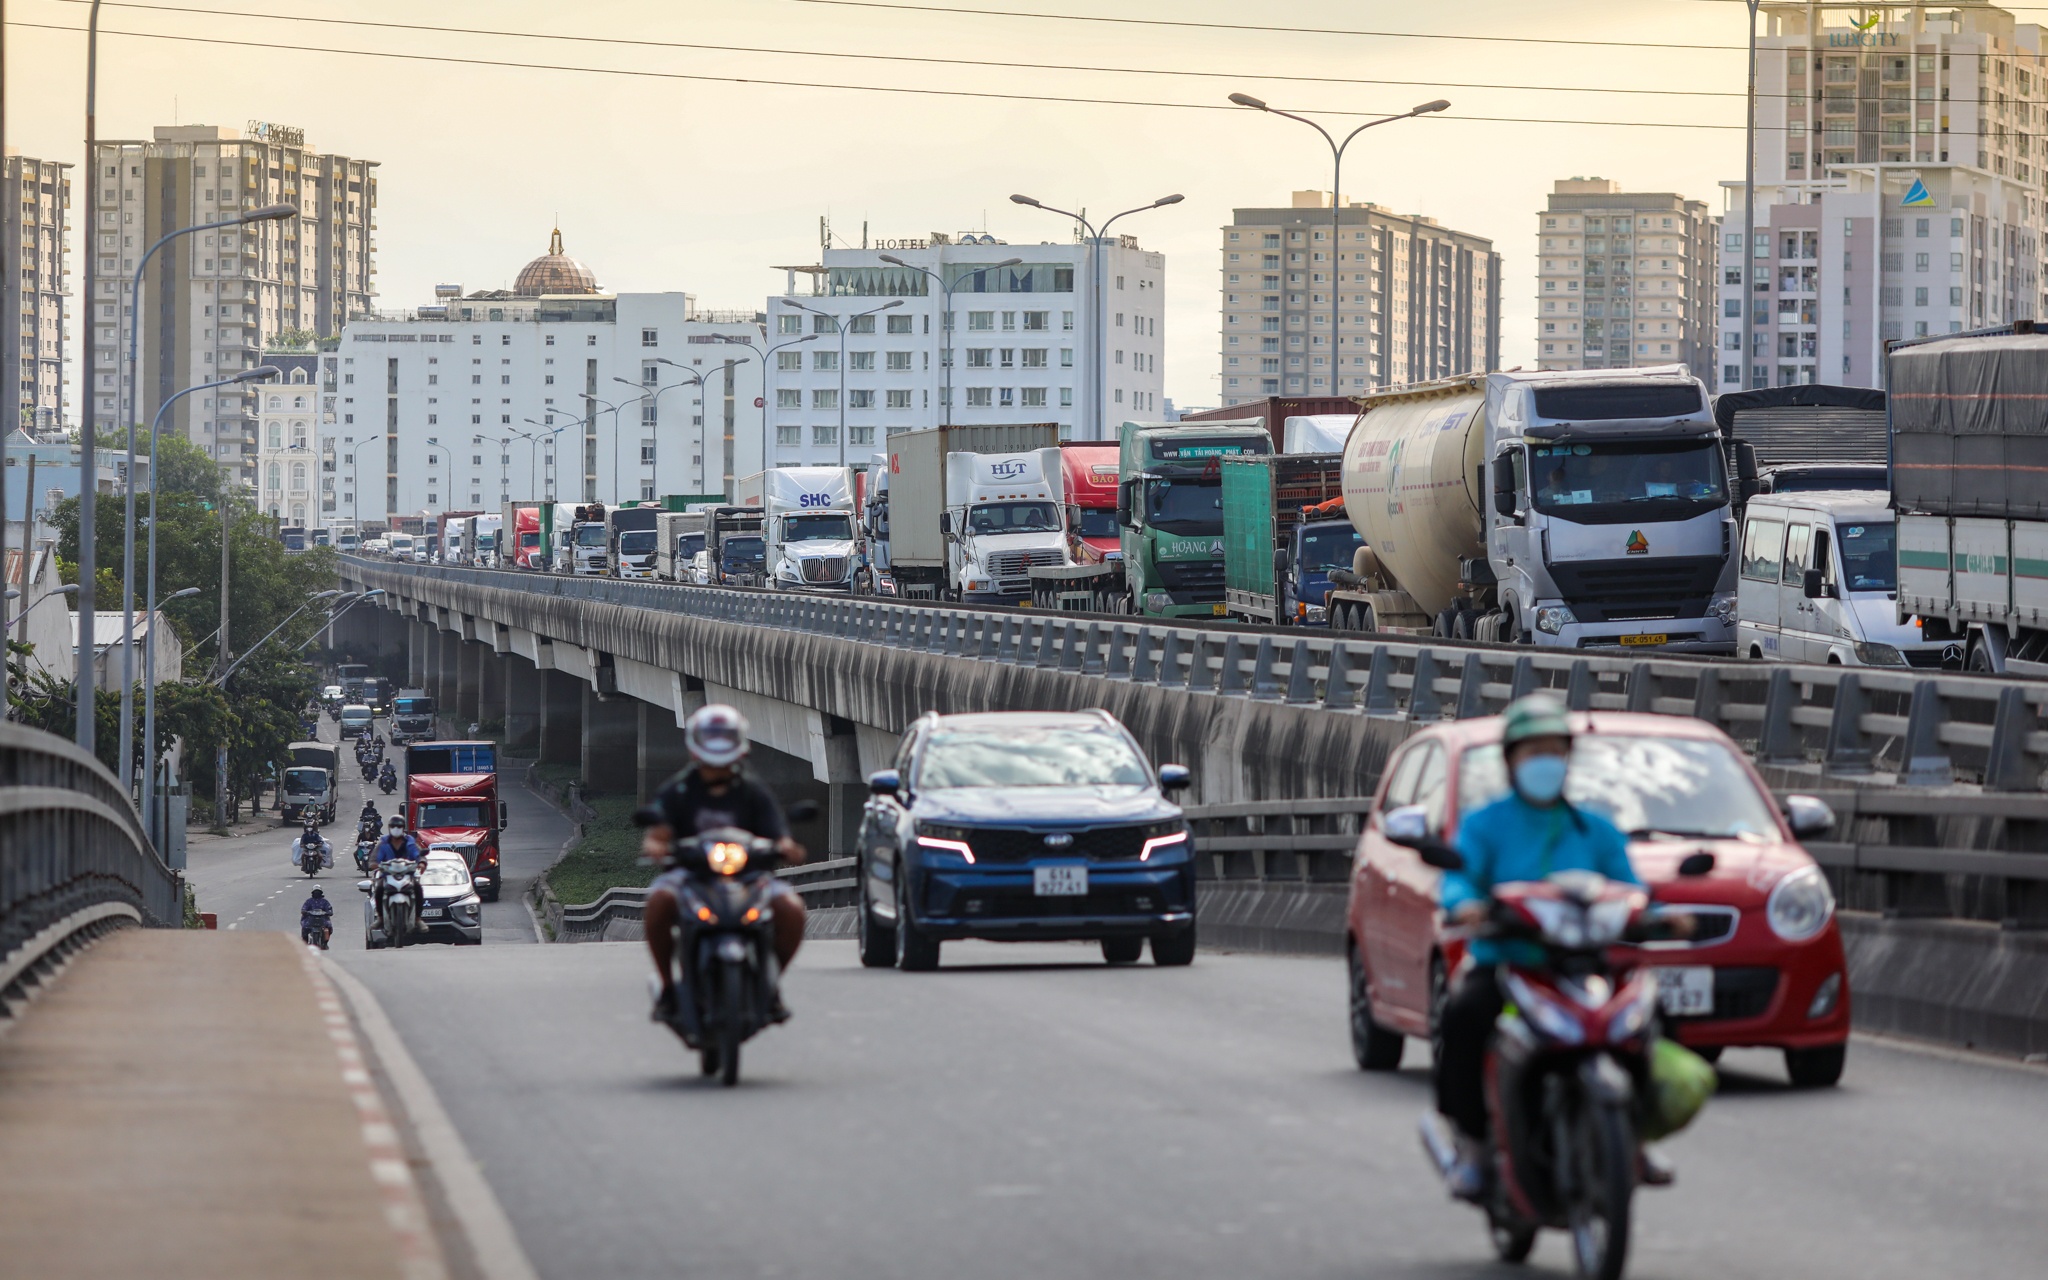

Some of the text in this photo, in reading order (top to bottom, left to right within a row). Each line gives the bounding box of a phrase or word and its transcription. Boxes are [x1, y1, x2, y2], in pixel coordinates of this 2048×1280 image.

[875, 239, 927, 250] HOTEL
[990, 463, 1027, 475] HLT
[800, 493, 831, 507] SHC
[1172, 540, 1207, 554] HOÀNG
[1624, 636, 1663, 644] 86C-051.45
